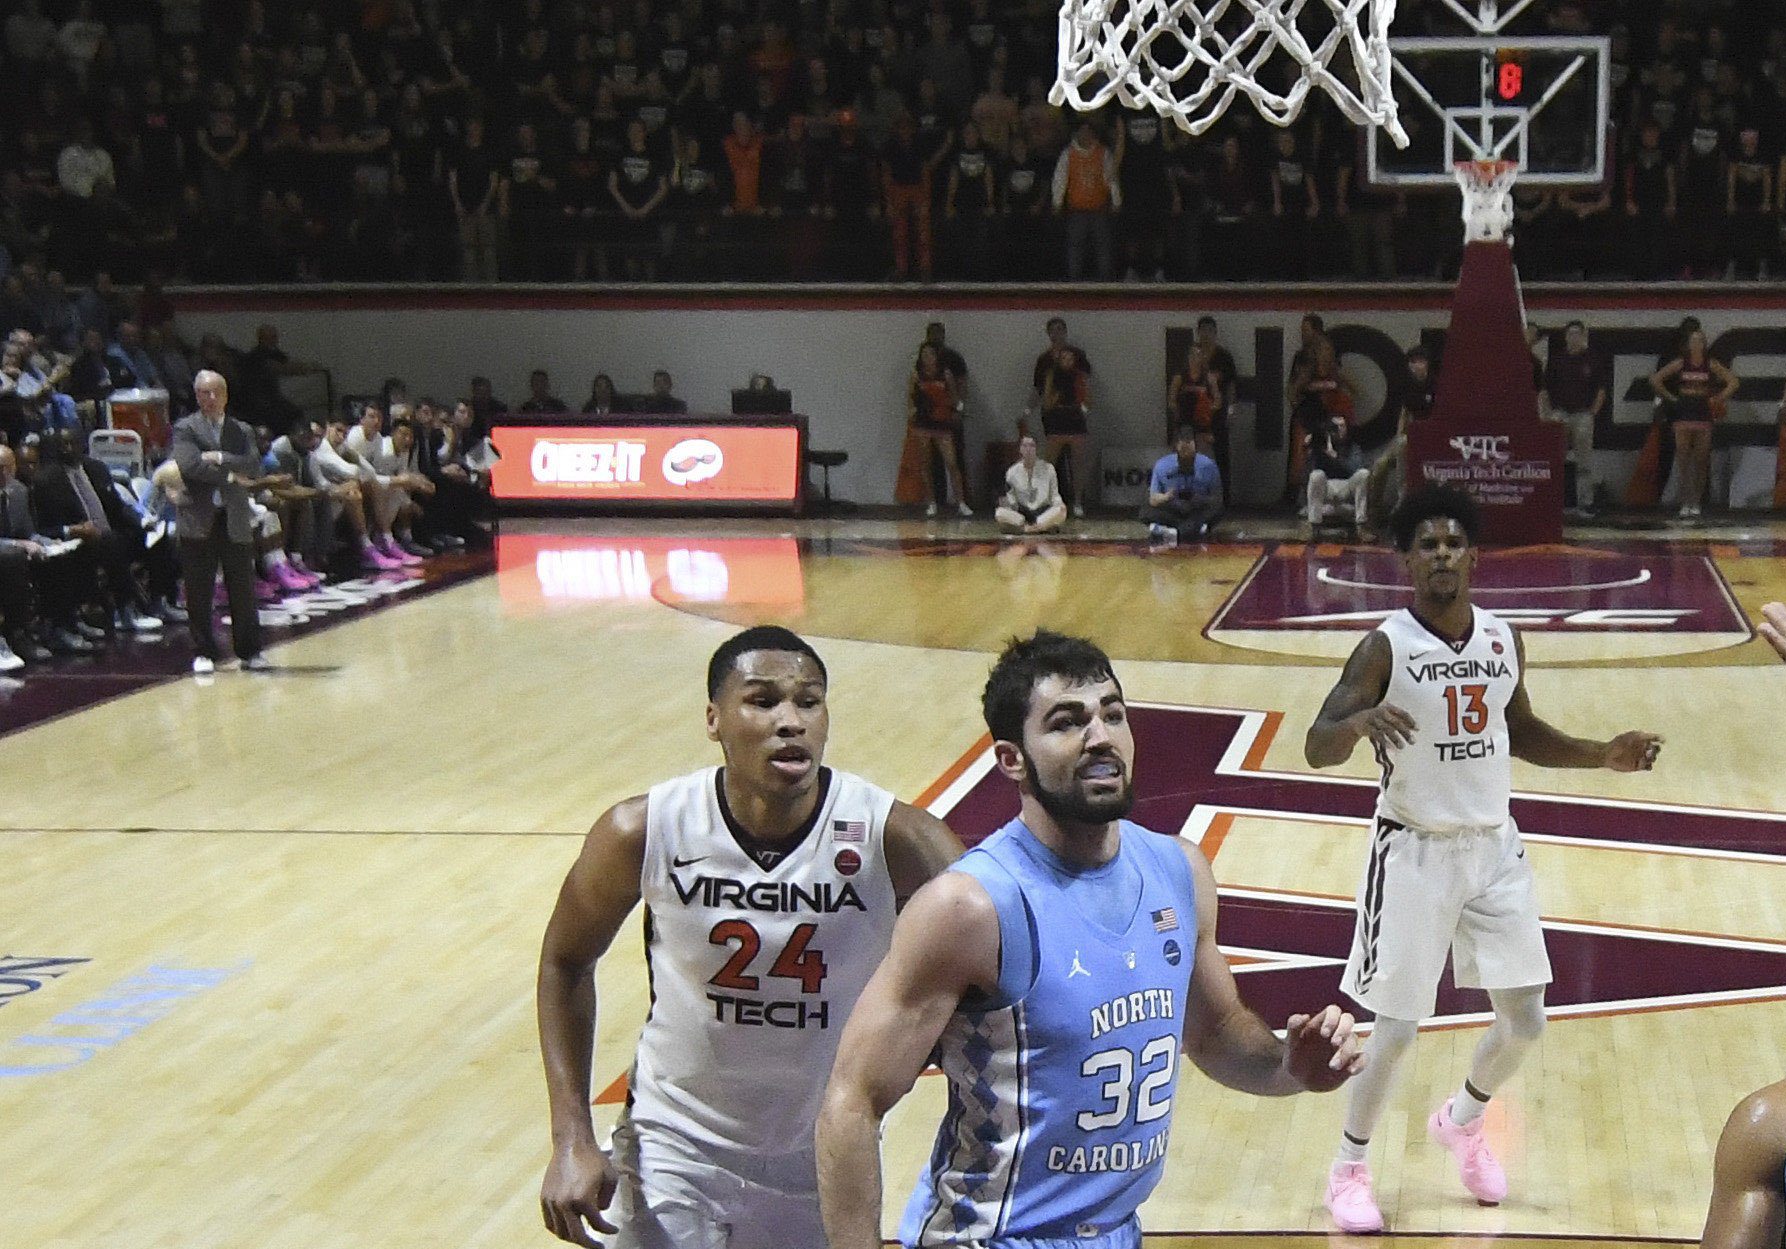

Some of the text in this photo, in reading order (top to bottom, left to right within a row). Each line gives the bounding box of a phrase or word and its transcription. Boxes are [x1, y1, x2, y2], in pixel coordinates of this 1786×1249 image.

[1406, 660, 1512, 683] VIRGINIA
[1443, 684, 1488, 736] 13
[1434, 736, 1495, 761] TECH
[755, 850, 781, 865] VT
[669, 872, 867, 914] VIRGINIA
[707, 919, 828, 994] 24
[706, 993, 829, 1029] TECH
[1090, 988, 1174, 1039] NORTH
[1076, 1033, 1177, 1132] 32
[1048, 1127, 1169, 1174] CAROLIN
